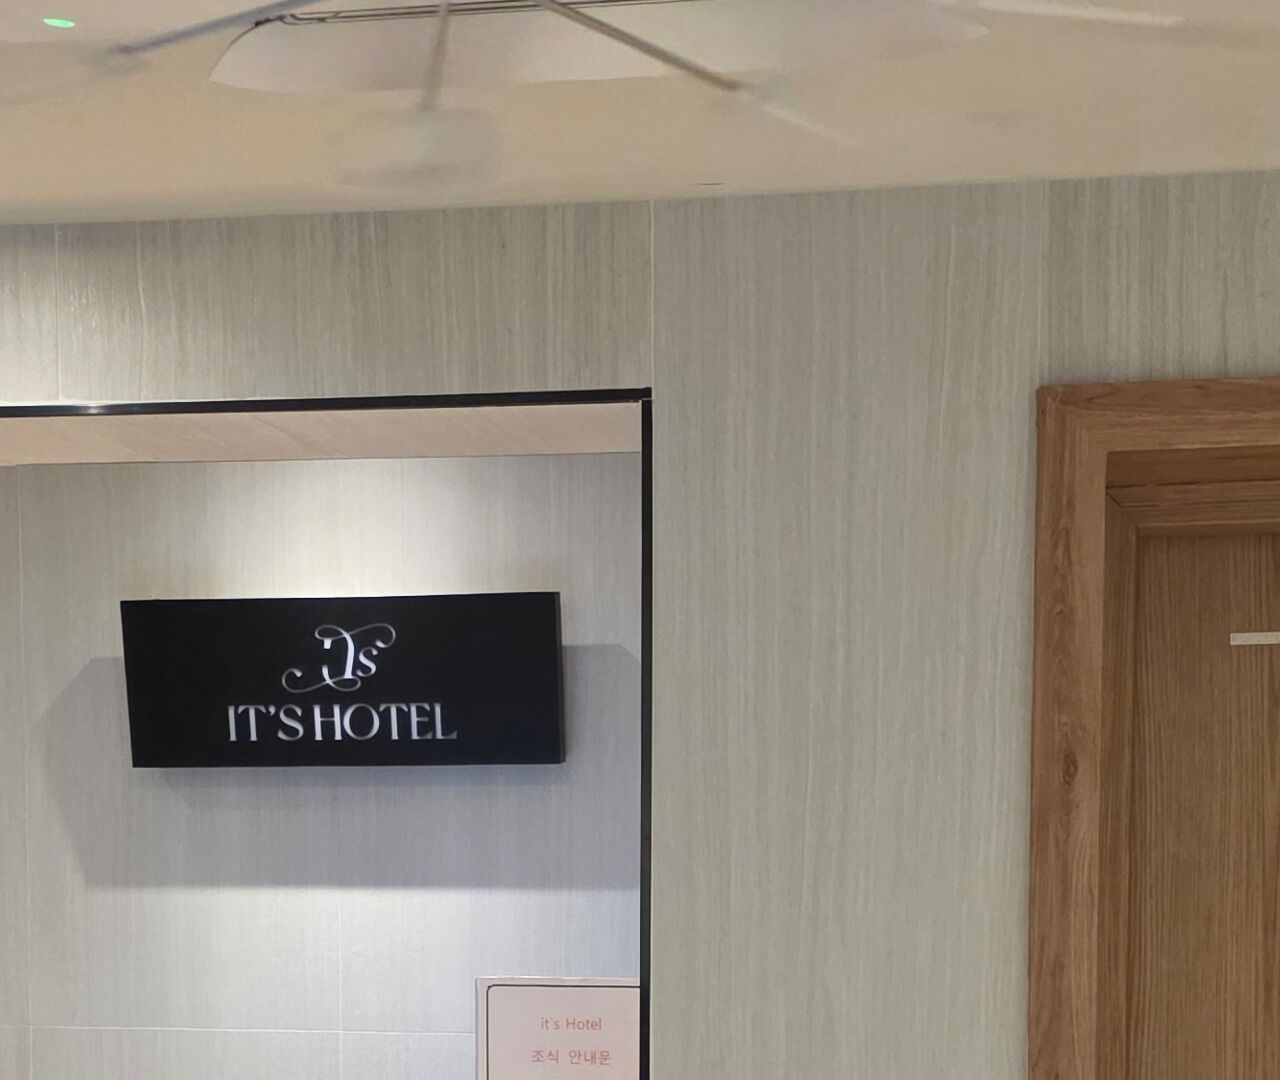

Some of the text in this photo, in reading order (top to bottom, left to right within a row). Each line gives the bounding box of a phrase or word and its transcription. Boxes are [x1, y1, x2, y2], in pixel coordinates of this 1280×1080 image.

[228, 702, 458, 742] IT'S HOTEL
[566, 1017, 602, 1031] Hotel
[531, 1050, 612, 1066] 조식 안내문
